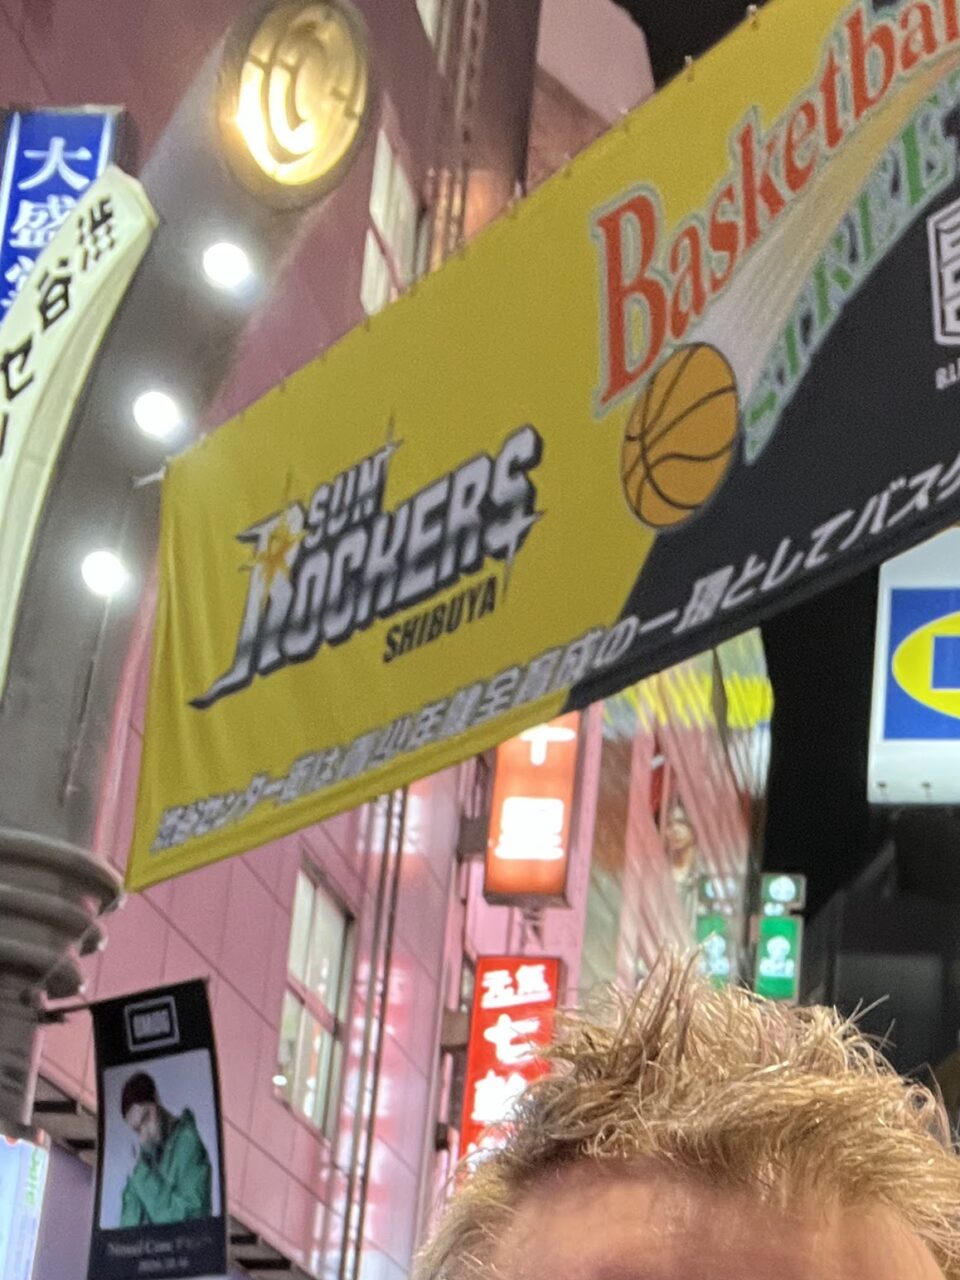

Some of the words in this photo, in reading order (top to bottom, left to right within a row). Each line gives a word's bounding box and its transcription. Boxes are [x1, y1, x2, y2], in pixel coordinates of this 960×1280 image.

[4, 136, 93, 310] 大盛
[303, 445, 395, 549] SUN
[383, 576, 497, 663] SHIBUYA
